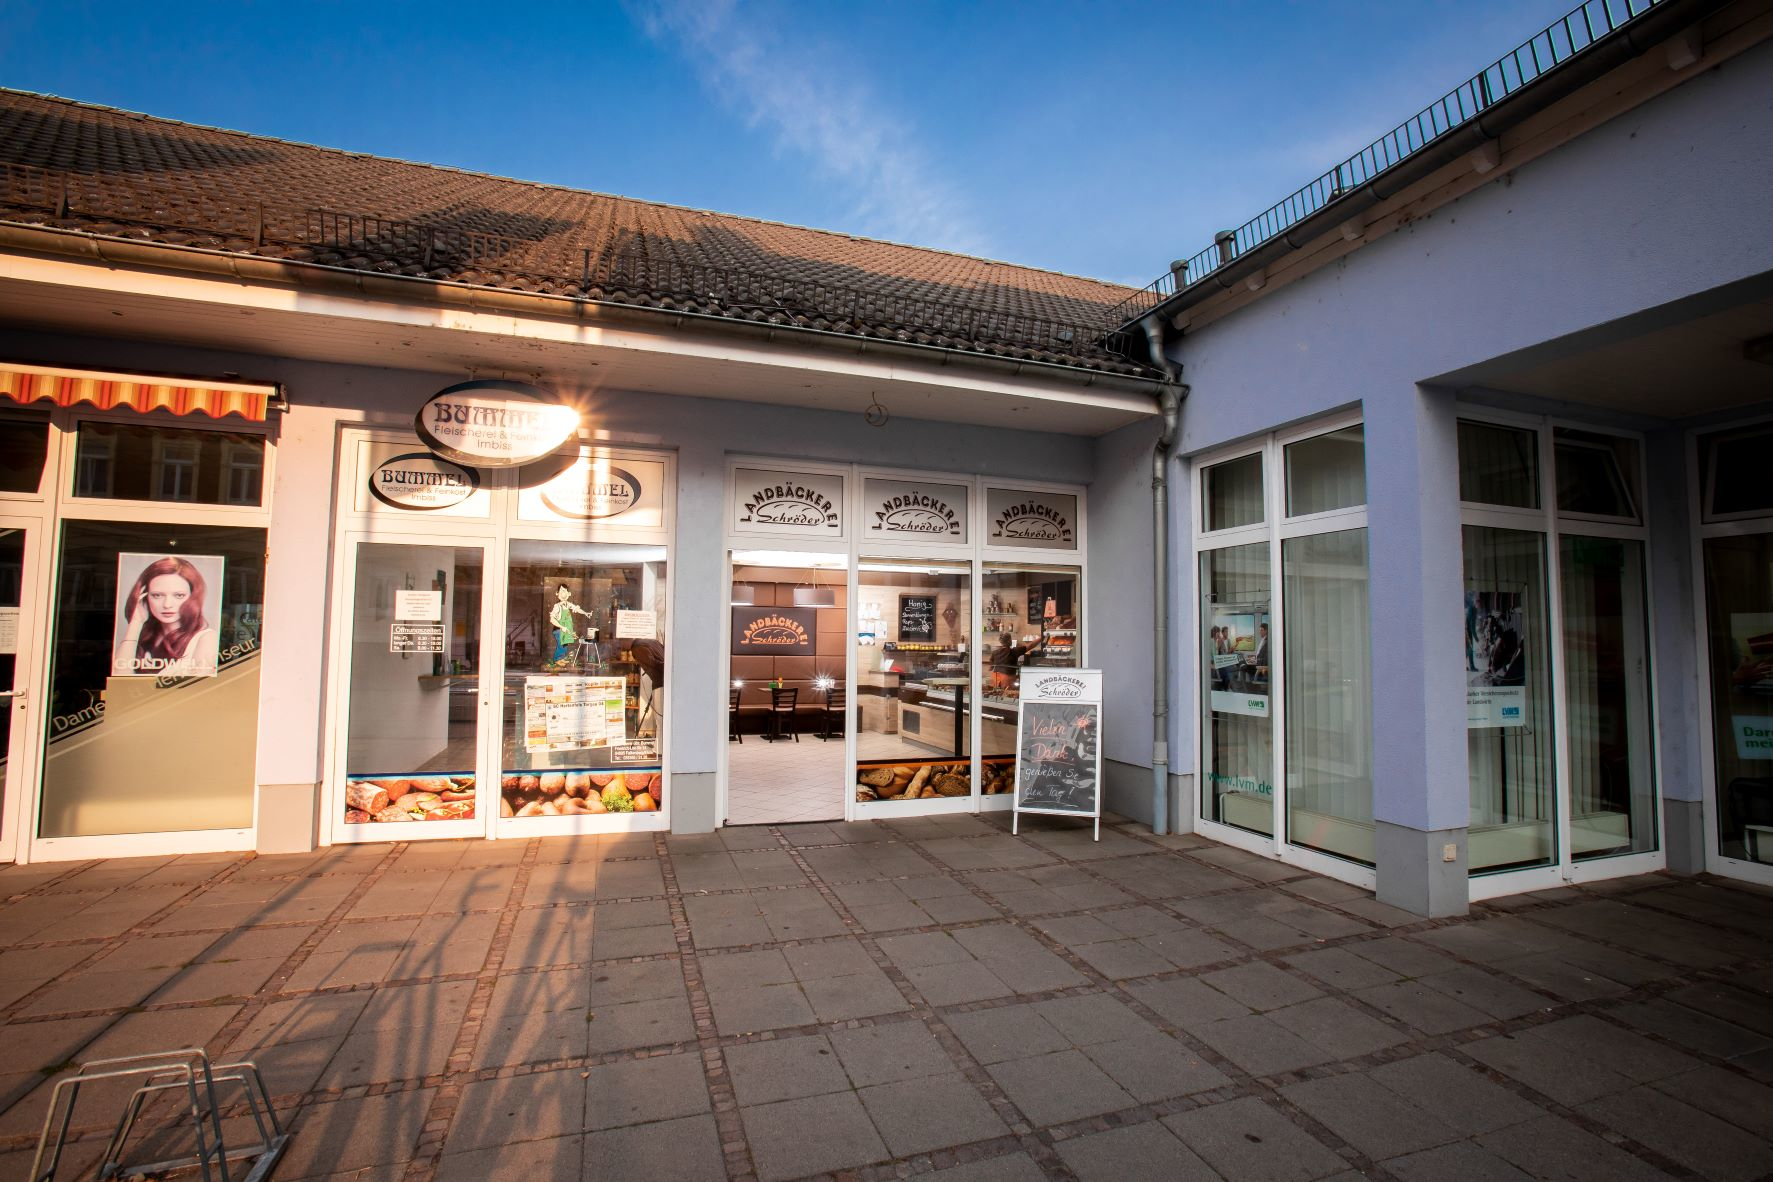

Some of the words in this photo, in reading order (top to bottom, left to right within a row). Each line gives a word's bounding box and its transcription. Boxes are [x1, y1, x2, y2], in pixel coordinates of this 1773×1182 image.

[434, 403, 552, 429] BUMME
[434, 425, 497, 438] Fleischerei
[500, 429, 508, 439] &
[477, 439, 513, 450] Imbiss
[381, 469, 467, 487] BUMMEL
[381, 485, 424, 494] Fleischerei
[434, 487, 466, 496] Feinkost
[740, 481, 838, 527] LANDBÄCKEREI
[757, 512, 820, 526] Schröder
[871, 491, 960, 535] LANDBÄCKEREI
[886, 520, 944, 533] Schröder
[992, 500, 1071, 542] LANDBÄCKEREI
[1006, 527, 1057, 540] Schröder
[908, 599, 927, 610] Honig
[395, 626, 442, 634] Öffnungszeiten
[740, 614, 808, 645] LANDBÄCKEREI
[114, 658, 208, 670] GOLDWELL
[1035, 675, 1086, 689] LANDBÄCKEREI
[1038, 685, 1080, 698] Schröder
[53, 702, 106, 731] Dame
[1030, 716, 1066, 736] Vielen
[1025, 766, 1063, 780] genießen
[1208, 772, 1272, 795] www.lvm.de
